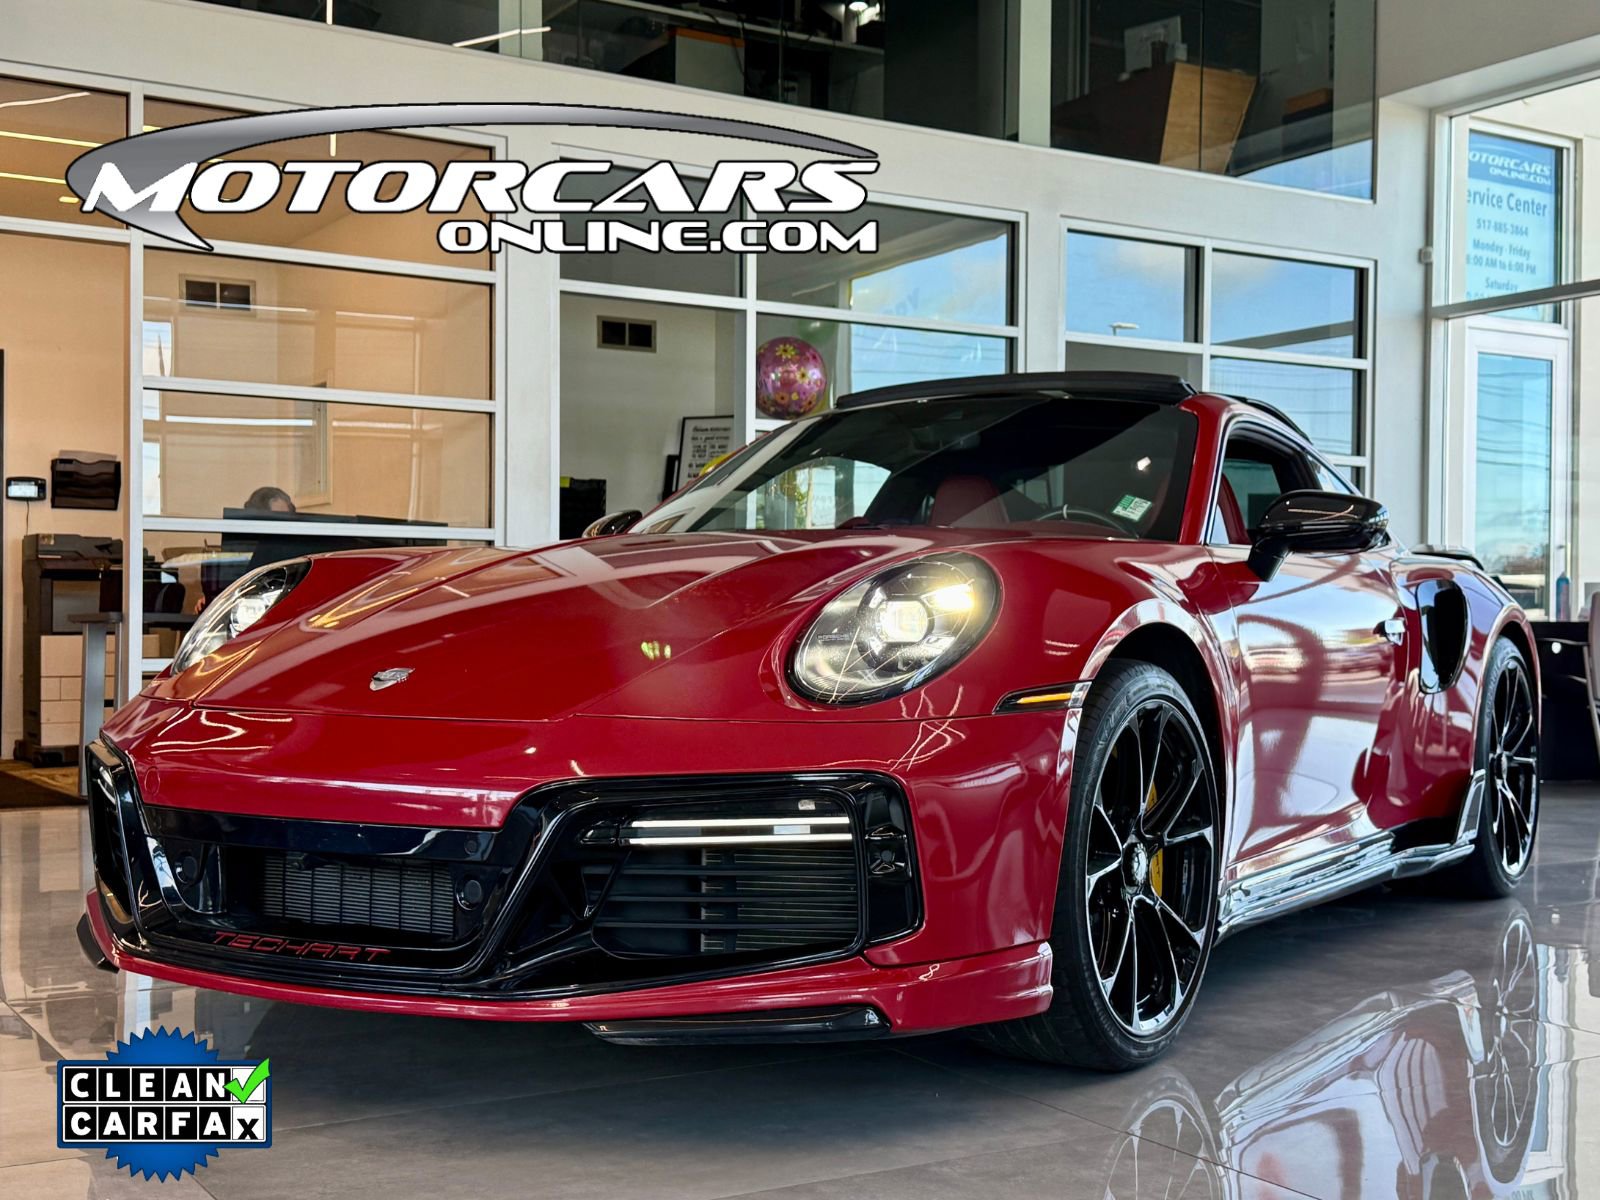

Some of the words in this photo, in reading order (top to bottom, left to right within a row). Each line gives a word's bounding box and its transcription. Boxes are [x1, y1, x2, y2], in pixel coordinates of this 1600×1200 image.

[1468, 151, 1551, 176] OTORCARS
[1466, 188, 1503, 209] ervice
[1507, 192, 1547, 216] Center
[1472, 239, 1504, 256] Monday
[1509, 244, 1531, 260] Friday
[1485, 257, 1497, 268] AM
[1485, 277, 1518, 292] Saturday
[212, 931, 391, 962] TECHART
